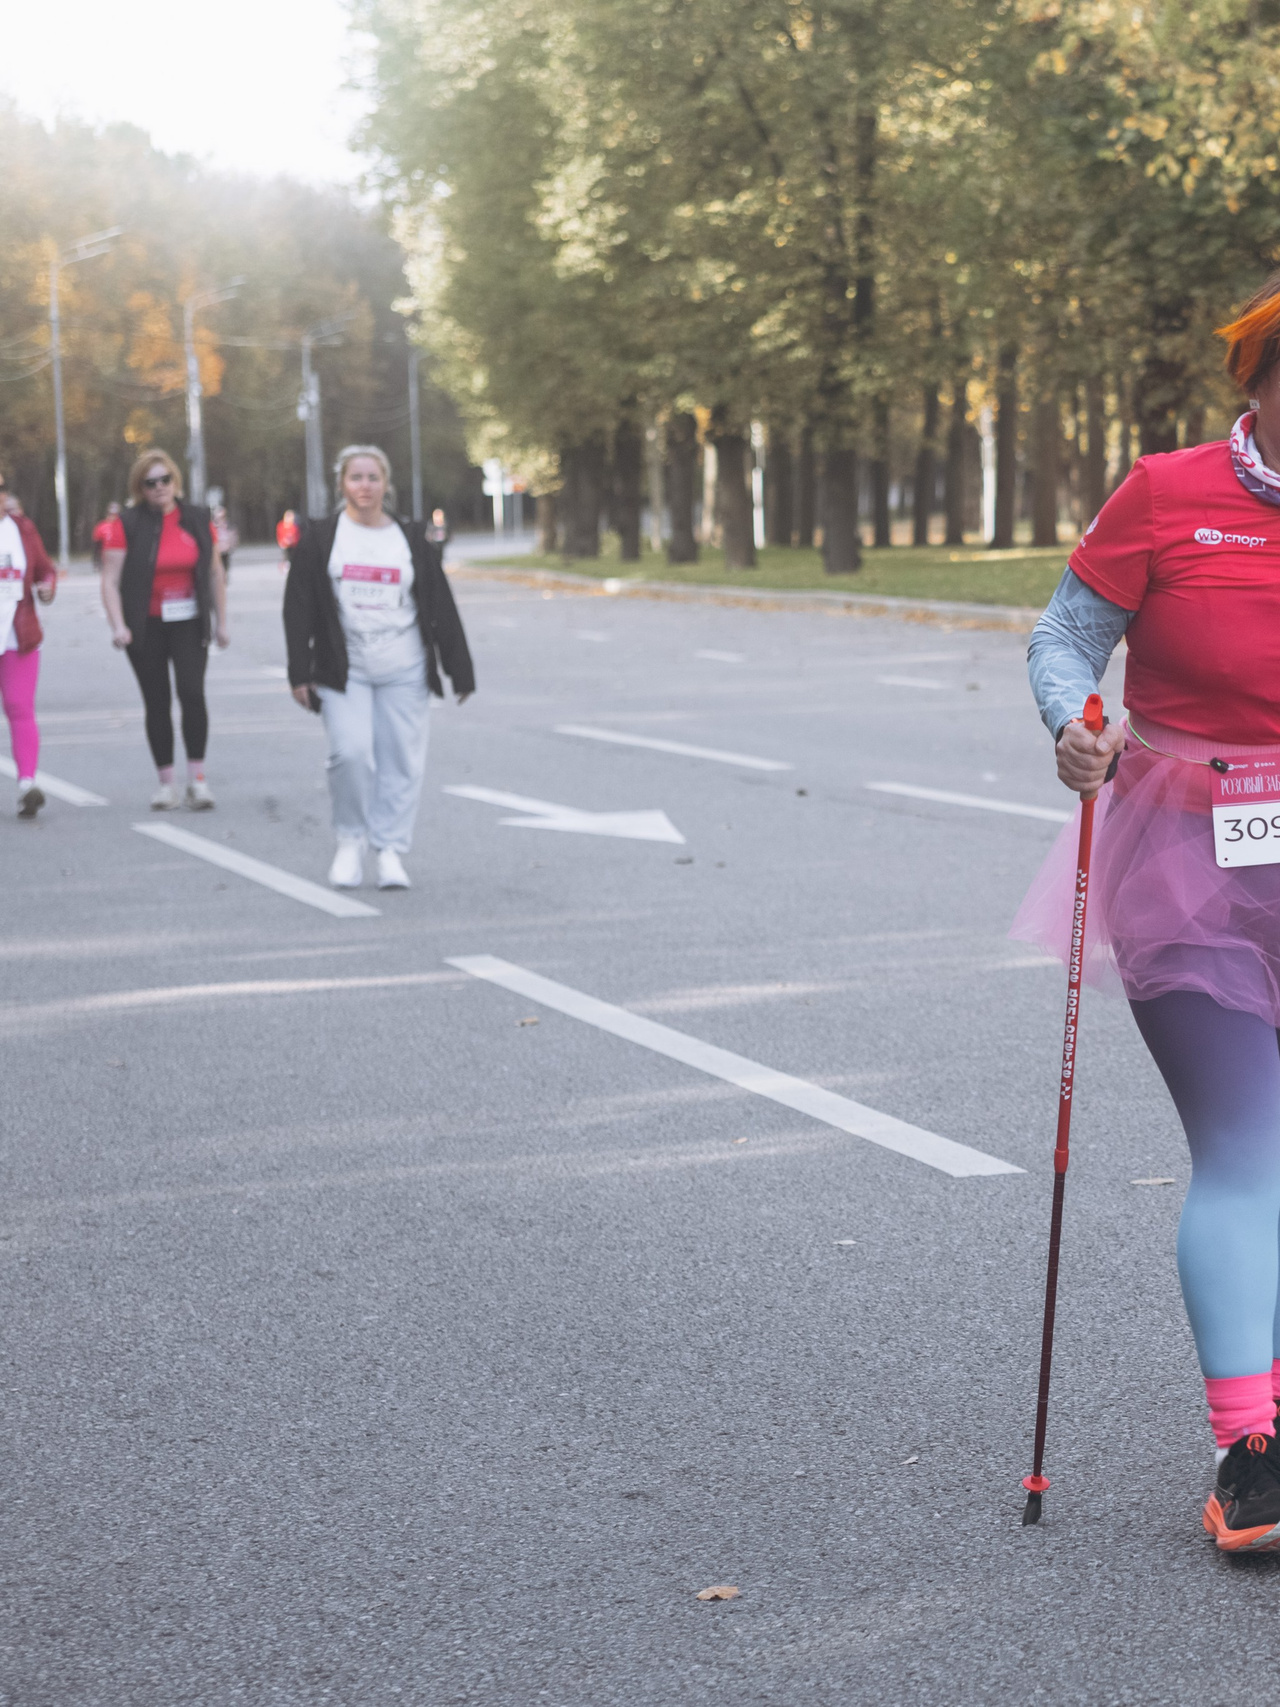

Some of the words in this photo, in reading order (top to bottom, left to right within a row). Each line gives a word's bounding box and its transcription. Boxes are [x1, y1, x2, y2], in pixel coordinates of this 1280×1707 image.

[1220, 774, 1264, 796] РОЗОВЫЙ
[1069, 891, 1086, 983] московское
[1062, 988, 1079, 1079] долголетие
